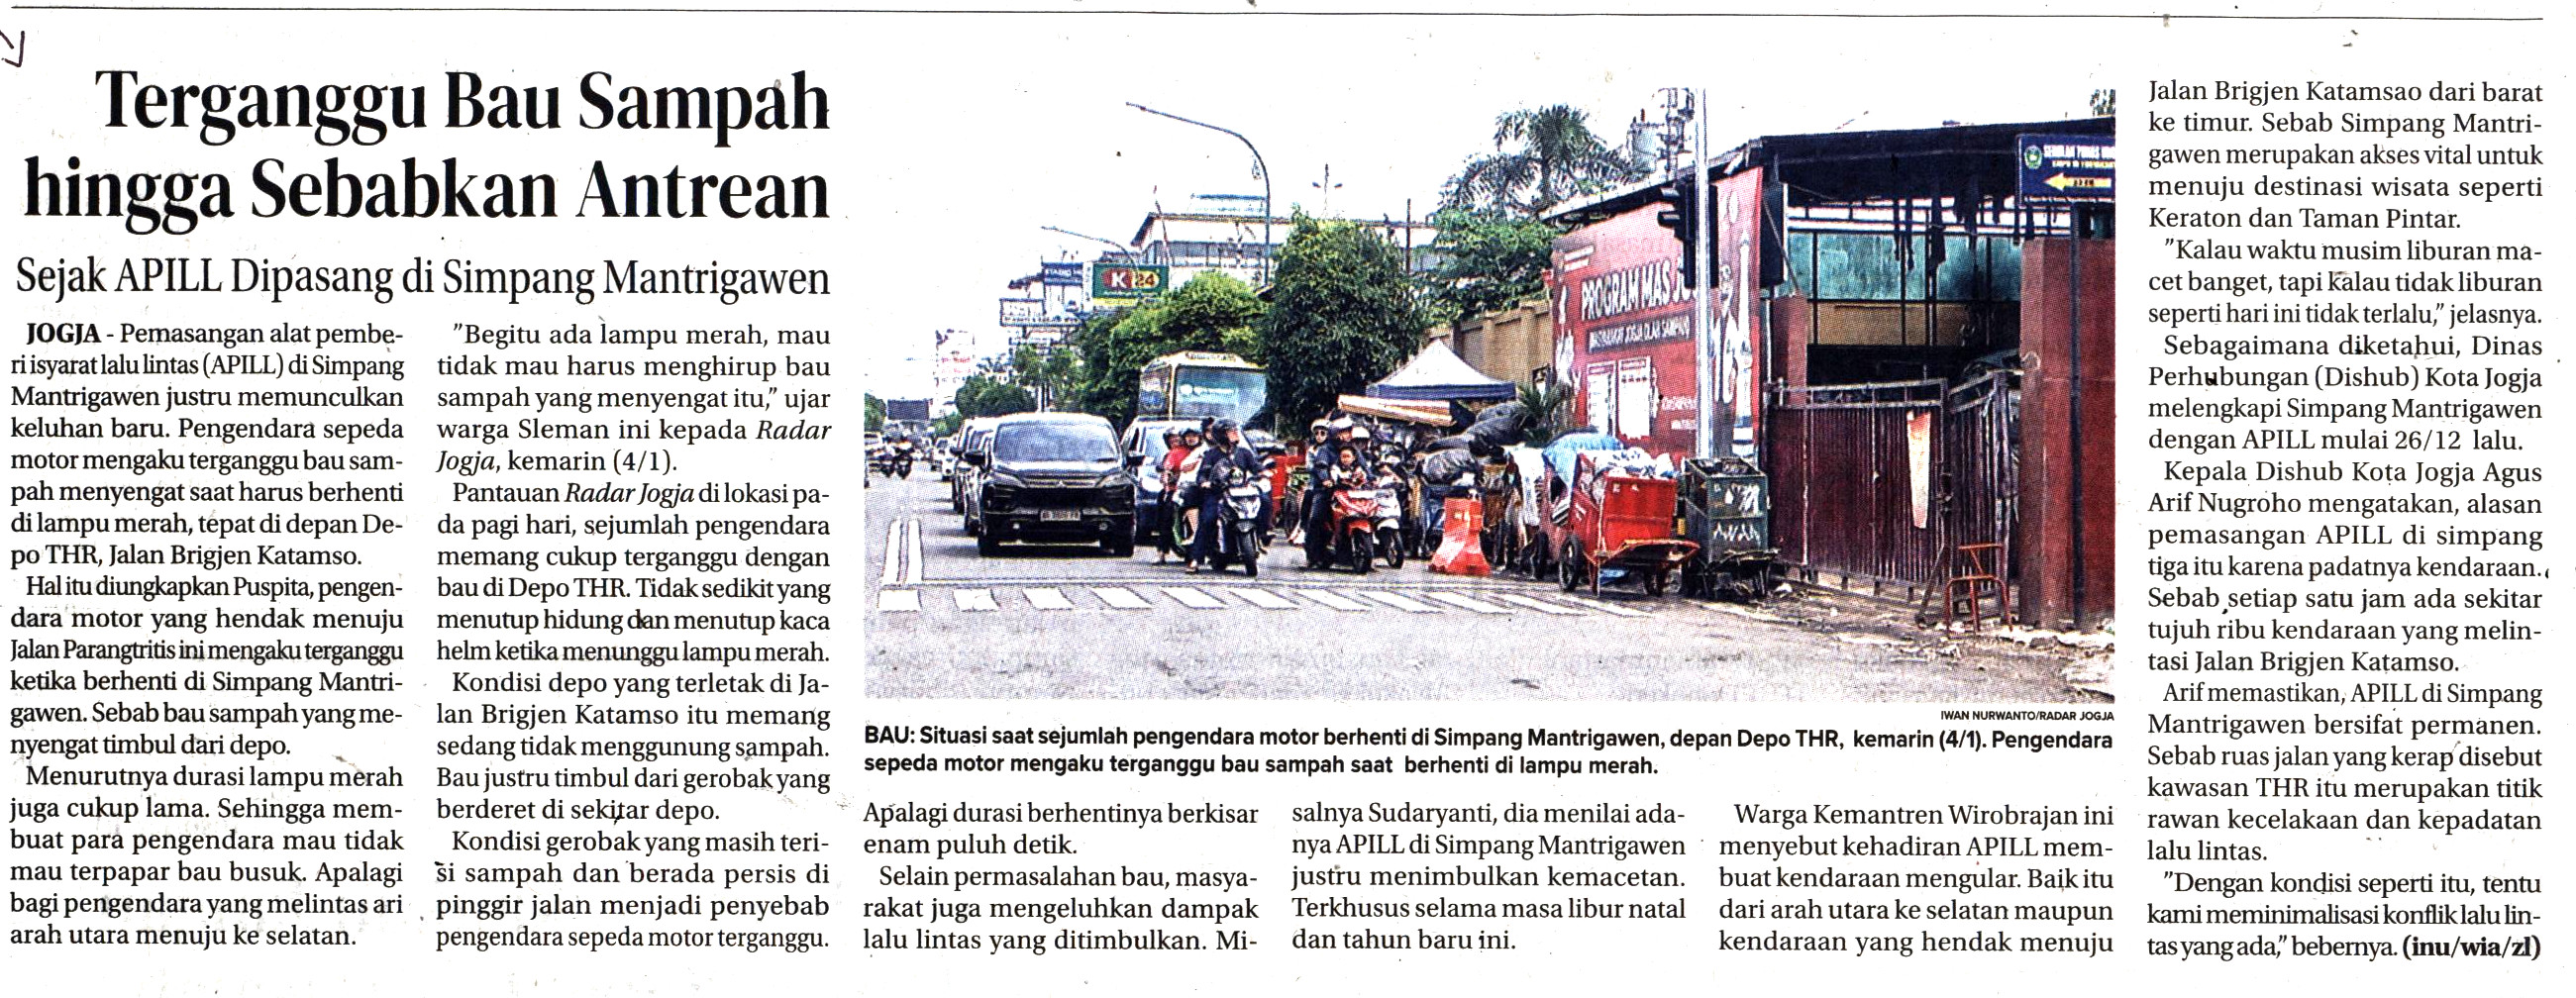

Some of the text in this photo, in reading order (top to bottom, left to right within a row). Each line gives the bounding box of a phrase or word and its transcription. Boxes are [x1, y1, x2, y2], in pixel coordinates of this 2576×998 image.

[2148, 78, 2543, 107] Jalan Brigjen Katamsao dari barat
[95, 69, 830, 149] Terganggu Bau Sampah
[24, 154, 830, 236] hingga Sebabkan Antrean
[2148, 174, 2543, 203] menuju destinasi wisata seperti
[2148, 206, 2461, 229] Keraton dan Taman Pintar.
[16, 255, 831, 306] Sejak APILL Dipasang di Simpang Mantrigawen
[1581, 266, 1640, 322] PROGRAM
[1641, 258, 1672, 310] MAS
[26, 322, 102, 347] JOGJA
[120, 323, 265, 349] Pemasangan
[269, 322, 312, 344] alat
[315, 322, 403, 349] pembe-
[437, 353, 831, 382] tidak mau harus menghirup bau
[2148, 396, 2542, 425] melengkapi Simpang Mantrigawen
[10, 416, 404, 445] keluhan baru. Pengendara sepeda
[436, 418, 833, 446] warga Sleman ini kepada Radar
[10, 479, 404, 508] pah menyengat saat harus berhenti
[2147, 491, 2542, 520] Arif Nugroho mengatakan, alasan
[437, 545, 831, 573] memang cukup terganggu dengan
[10, 669, 403, 698] ketika berhenti di Simpang Mantri-
[436, 702, 831, 732] lan Brigjen Katamso itu memang
[1940, 710, 2114, 722] IWAN NURWANTO/RADAR JOGJA
[865, 725, 2112, 753] BAU: Situasi saat sejumlah pengendara motor berhenti di Simpang Mantrigawen, depan Depo THR, kemarin (4/1). Pengendara
[864, 752, 1659, 778] sepeda motor mengaku terganggu bau sampah saat berhenti di lampu merah.
[8, 796, 403, 825] juga cukup lama. Sehingga mem-
[863, 801, 1259, 830] Apalagi durasi berhentinya berkisar
[1733, 803, 2114, 832] Warga Kemantren Wirobrajan ini
[2147, 808, 2542, 836] rawan kecelakaan dan kepadatan
[1291, 833, 1687, 861] nya APILL di Simpang Mantrigawen
[10, 859, 403, 888] mau terpapar bau busuk. Apalagi
[436, 893, 830, 922] pinggir jalan menjadi penyebab
[863, 896, 1260, 925] rakat juga mengeluhkan dampak
[1291, 896, 1687, 919] Terkhusus selama masa libur natal
[1718, 929, 2113, 958] kendaraan yang hendak menuju
